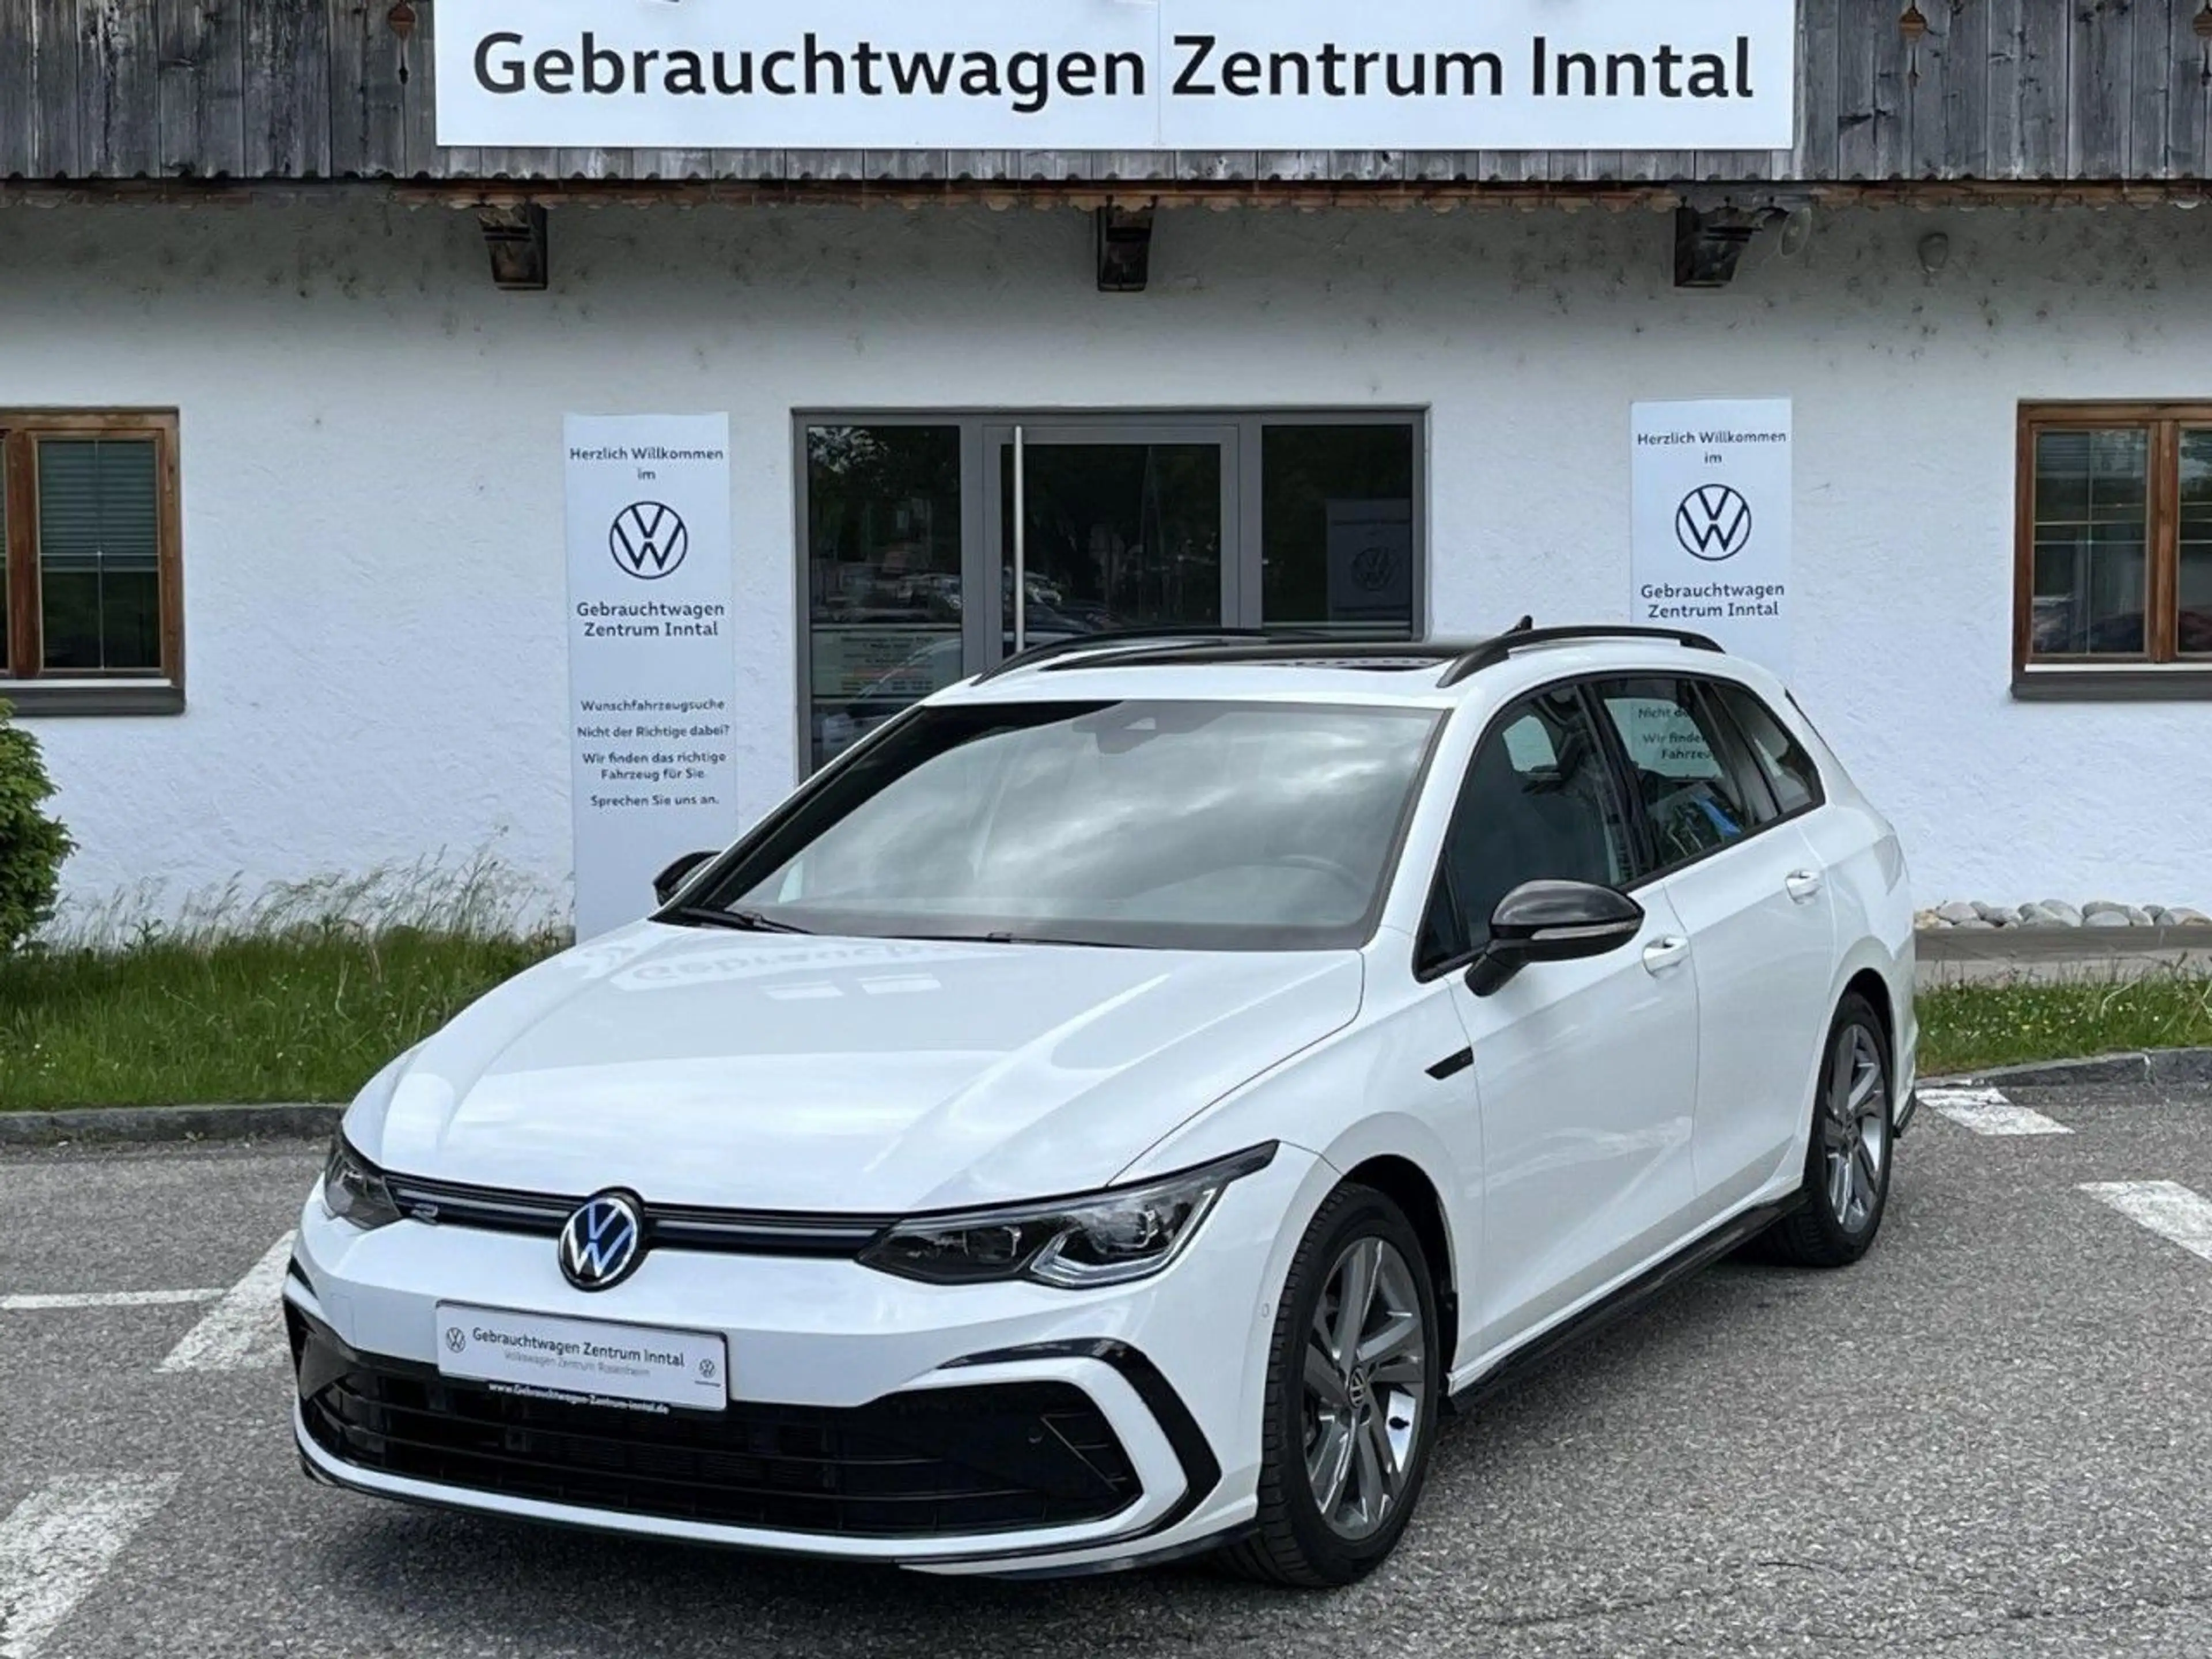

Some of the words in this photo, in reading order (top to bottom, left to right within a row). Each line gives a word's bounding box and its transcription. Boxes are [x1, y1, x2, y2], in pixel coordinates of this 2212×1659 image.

[474, 33, 1144, 113] Gebrauchtwagen
[1172, 34, 1502, 97] Zentrum
[1533, 36, 1753, 99] Inntal
[1638, 433, 1695, 445] Herzlich
[1699, 431, 1786, 444] Willkommen
[570, 448, 628, 460] Herzlich
[631, 447, 724, 460] Willkommen
[1705, 453, 1722, 464] im
[637, 468, 656, 479] im
[1641, 583, 1785, 599] Gebrauchtwagen
[577, 601, 724, 619] Gebrauchtwagen
[1648, 604, 1722, 618] Zentrum
[1728, 601, 1778, 616] Inntal
[584, 622, 660, 637] Zentrum
[665, 621, 718, 636] Inntal
[581, 699, 725, 713] Wunschfahrzeugsuche
[577, 726, 610, 738] Nicht
[613, 727, 632, 737] der
[636, 726, 687, 738] Richtige
[690, 724, 729, 736] dabei?
[1669, 731, 1703, 744] finde
[582, 753, 605, 764] Wir
[608, 751, 649, 763] finden
[652, 752, 674, 763] das
[677, 751, 726, 764] richtige
[601, 769, 660, 782] Fahrzeug
[663, 767, 682, 778] für
[590, 795, 649, 808] Sprechen
[652, 795, 671, 805] Sie
[675, 797, 697, 805] uns
[472, 1327, 581, 1355] Gebrauchtwagen
[582, 1341, 641, 1362] Zentrum
[643, 1348, 685, 1368] Inntal
